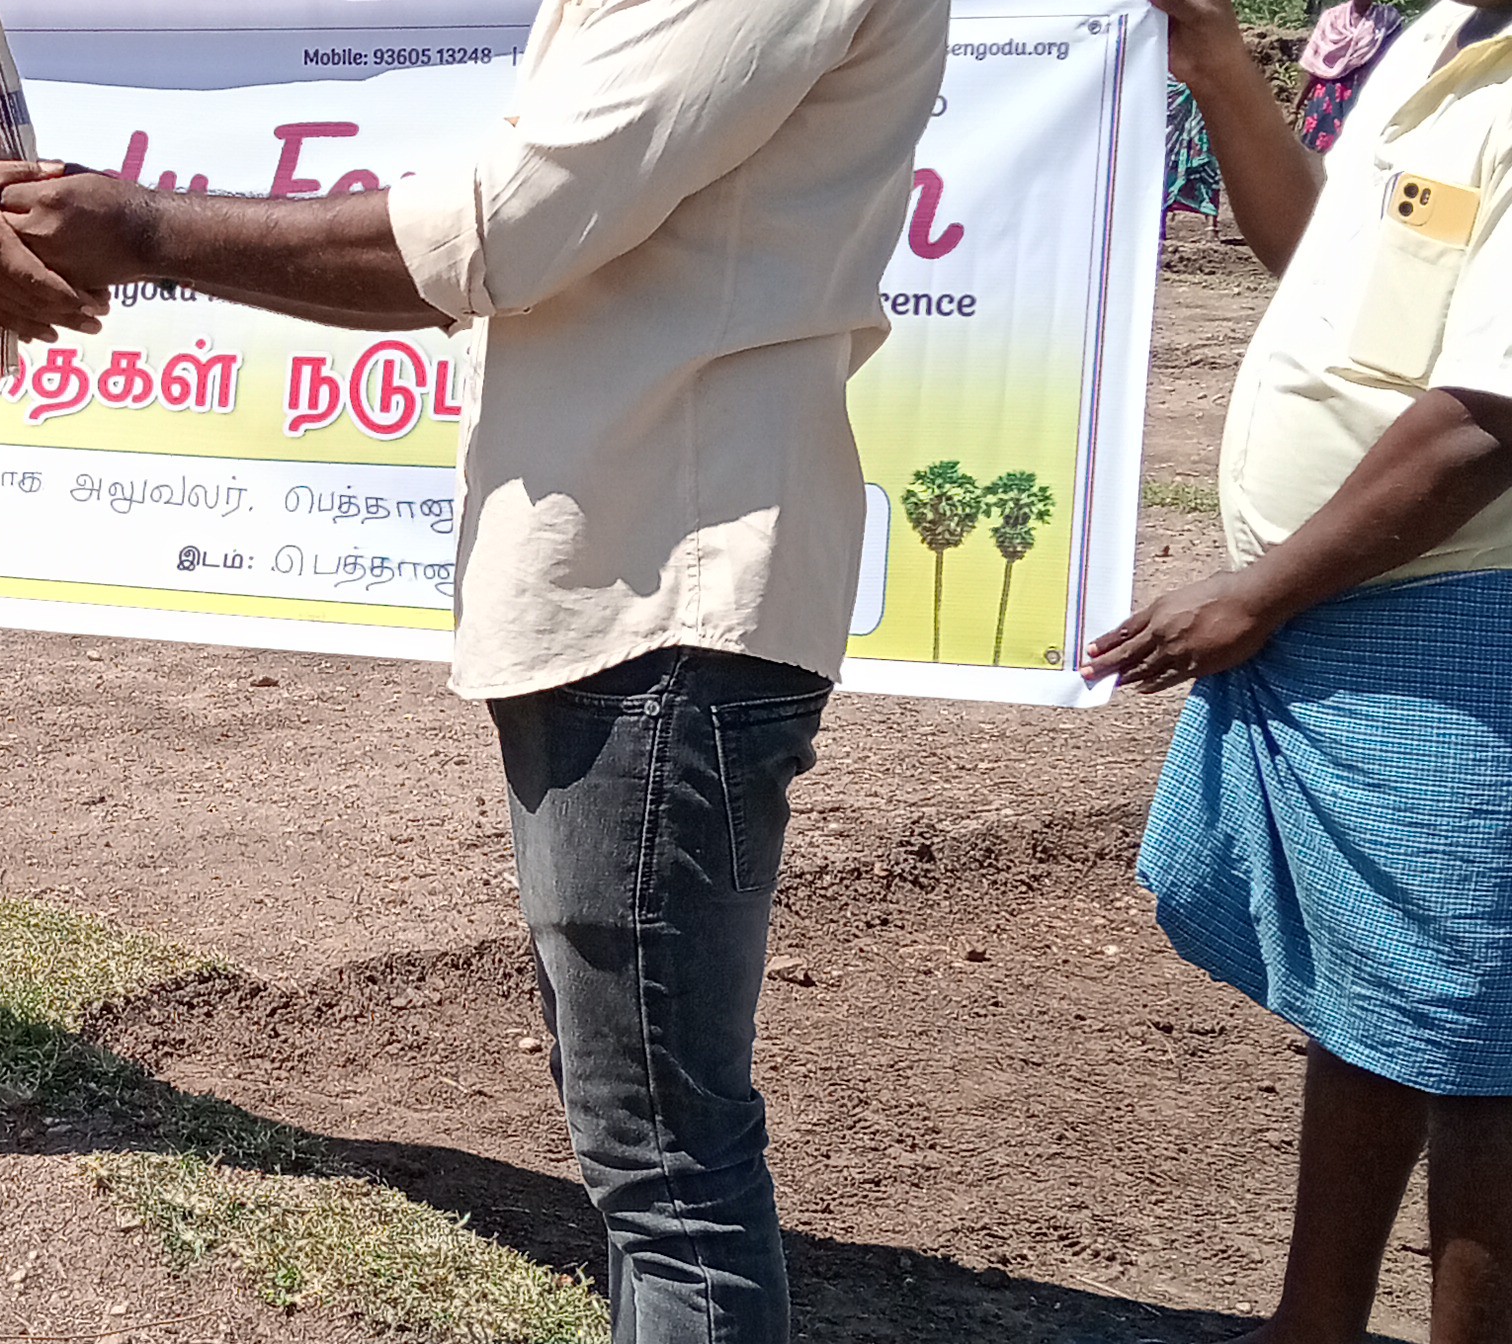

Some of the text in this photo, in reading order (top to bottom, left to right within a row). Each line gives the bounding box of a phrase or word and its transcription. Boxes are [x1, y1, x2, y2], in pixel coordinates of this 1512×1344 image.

[303, 46, 492, 66] Mobile: 93605 13248
[945, 38, 1071, 61] engodu.org
